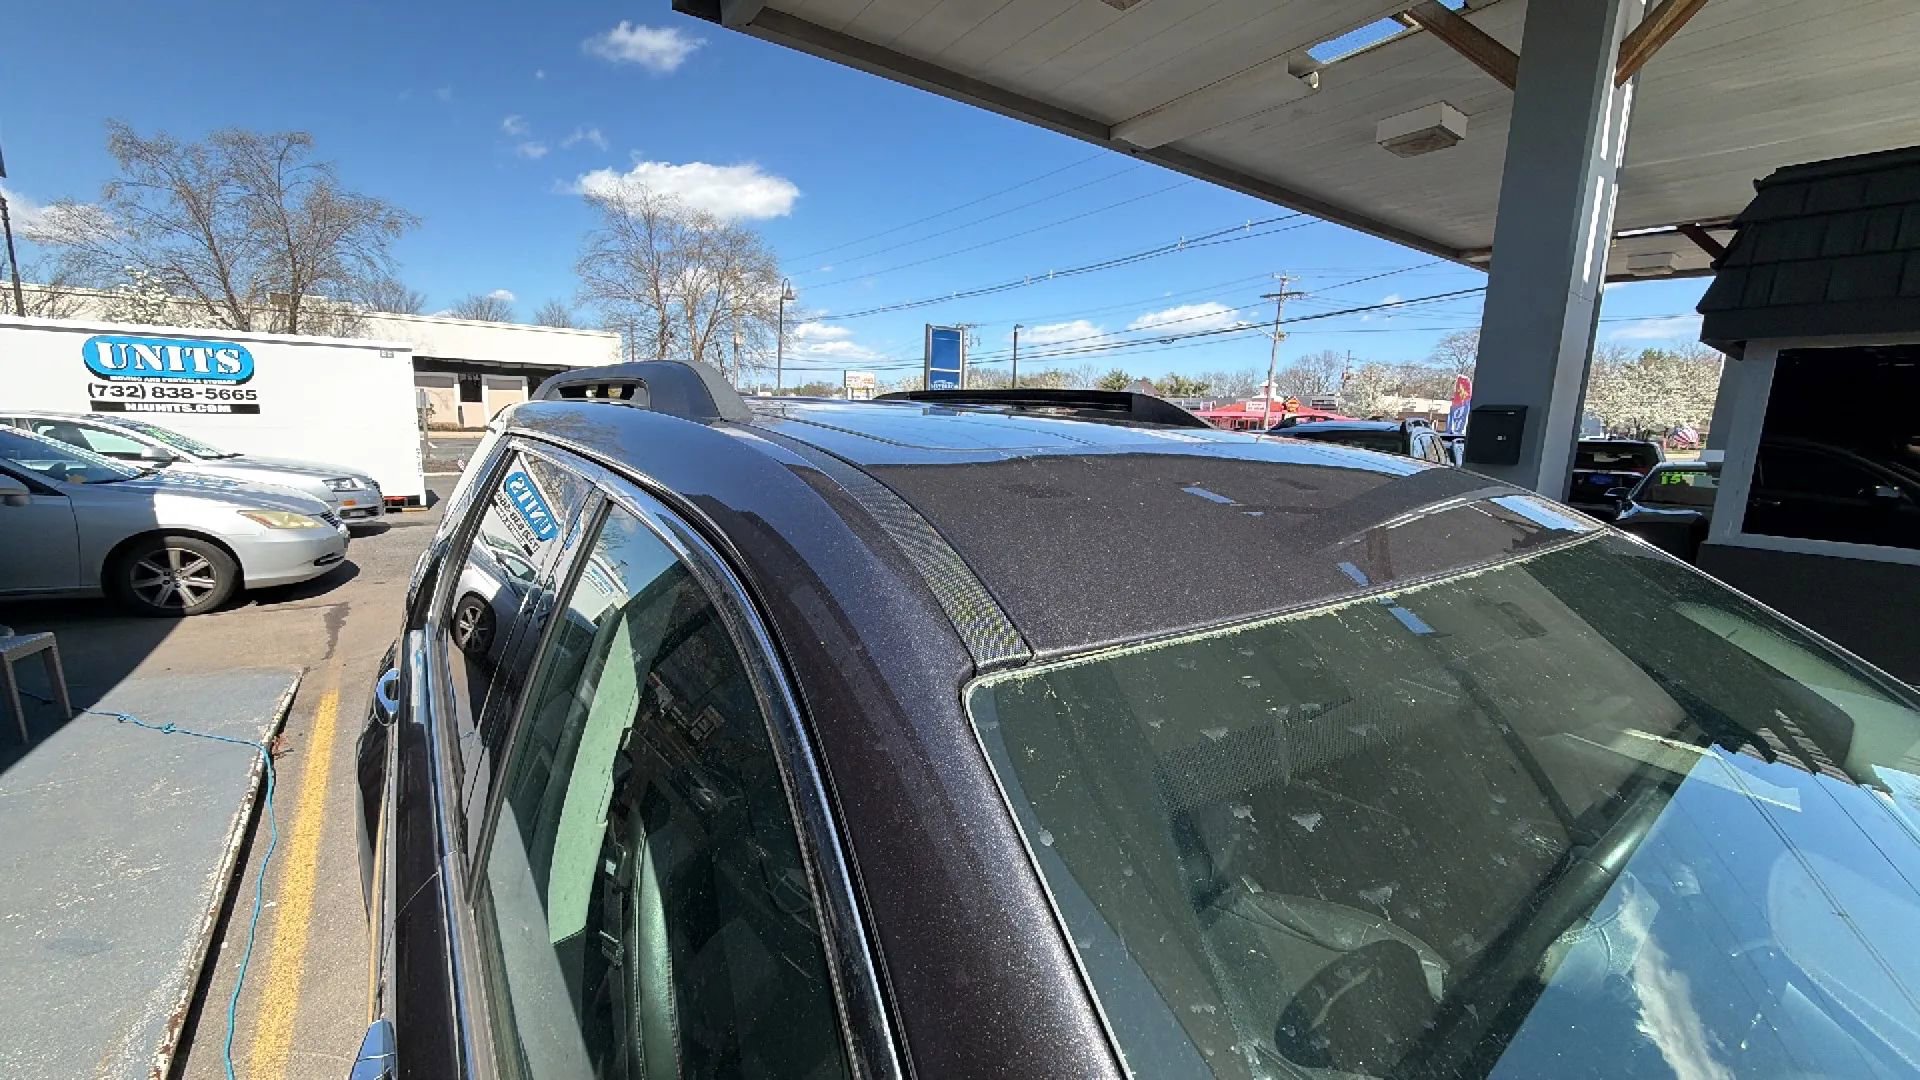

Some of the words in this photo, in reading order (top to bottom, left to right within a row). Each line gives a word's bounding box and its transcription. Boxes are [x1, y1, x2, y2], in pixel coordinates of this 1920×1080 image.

[95, 341, 242, 375] UNITS
[87, 382, 147, 399] (732)
[152, 386, 258, 401] 838-5665
